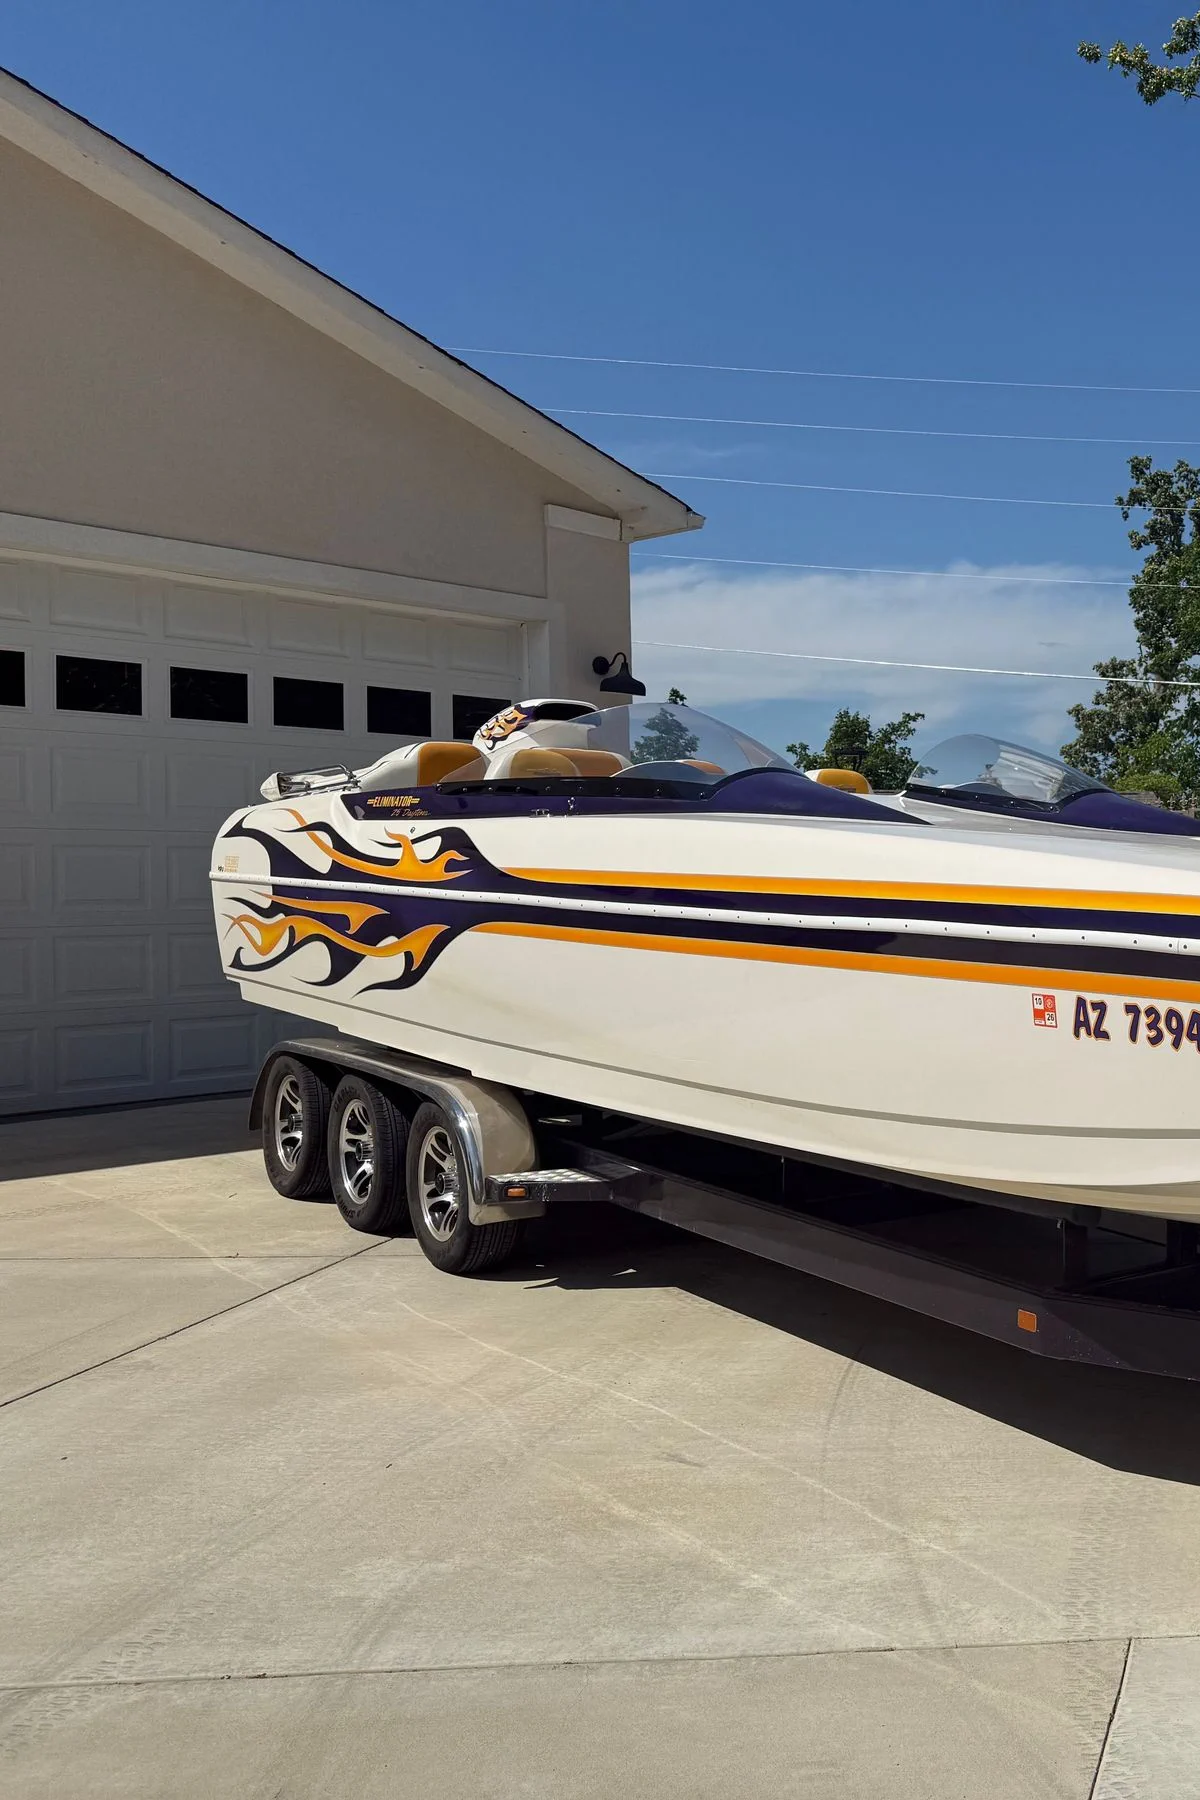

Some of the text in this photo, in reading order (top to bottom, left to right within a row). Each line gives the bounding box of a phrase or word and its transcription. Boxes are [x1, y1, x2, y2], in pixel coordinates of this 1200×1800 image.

[372, 796, 414, 808] ELIMINATOR
[1046, 1013, 1055, 1022] 26
[1073, 995, 1111, 1041] AZ
